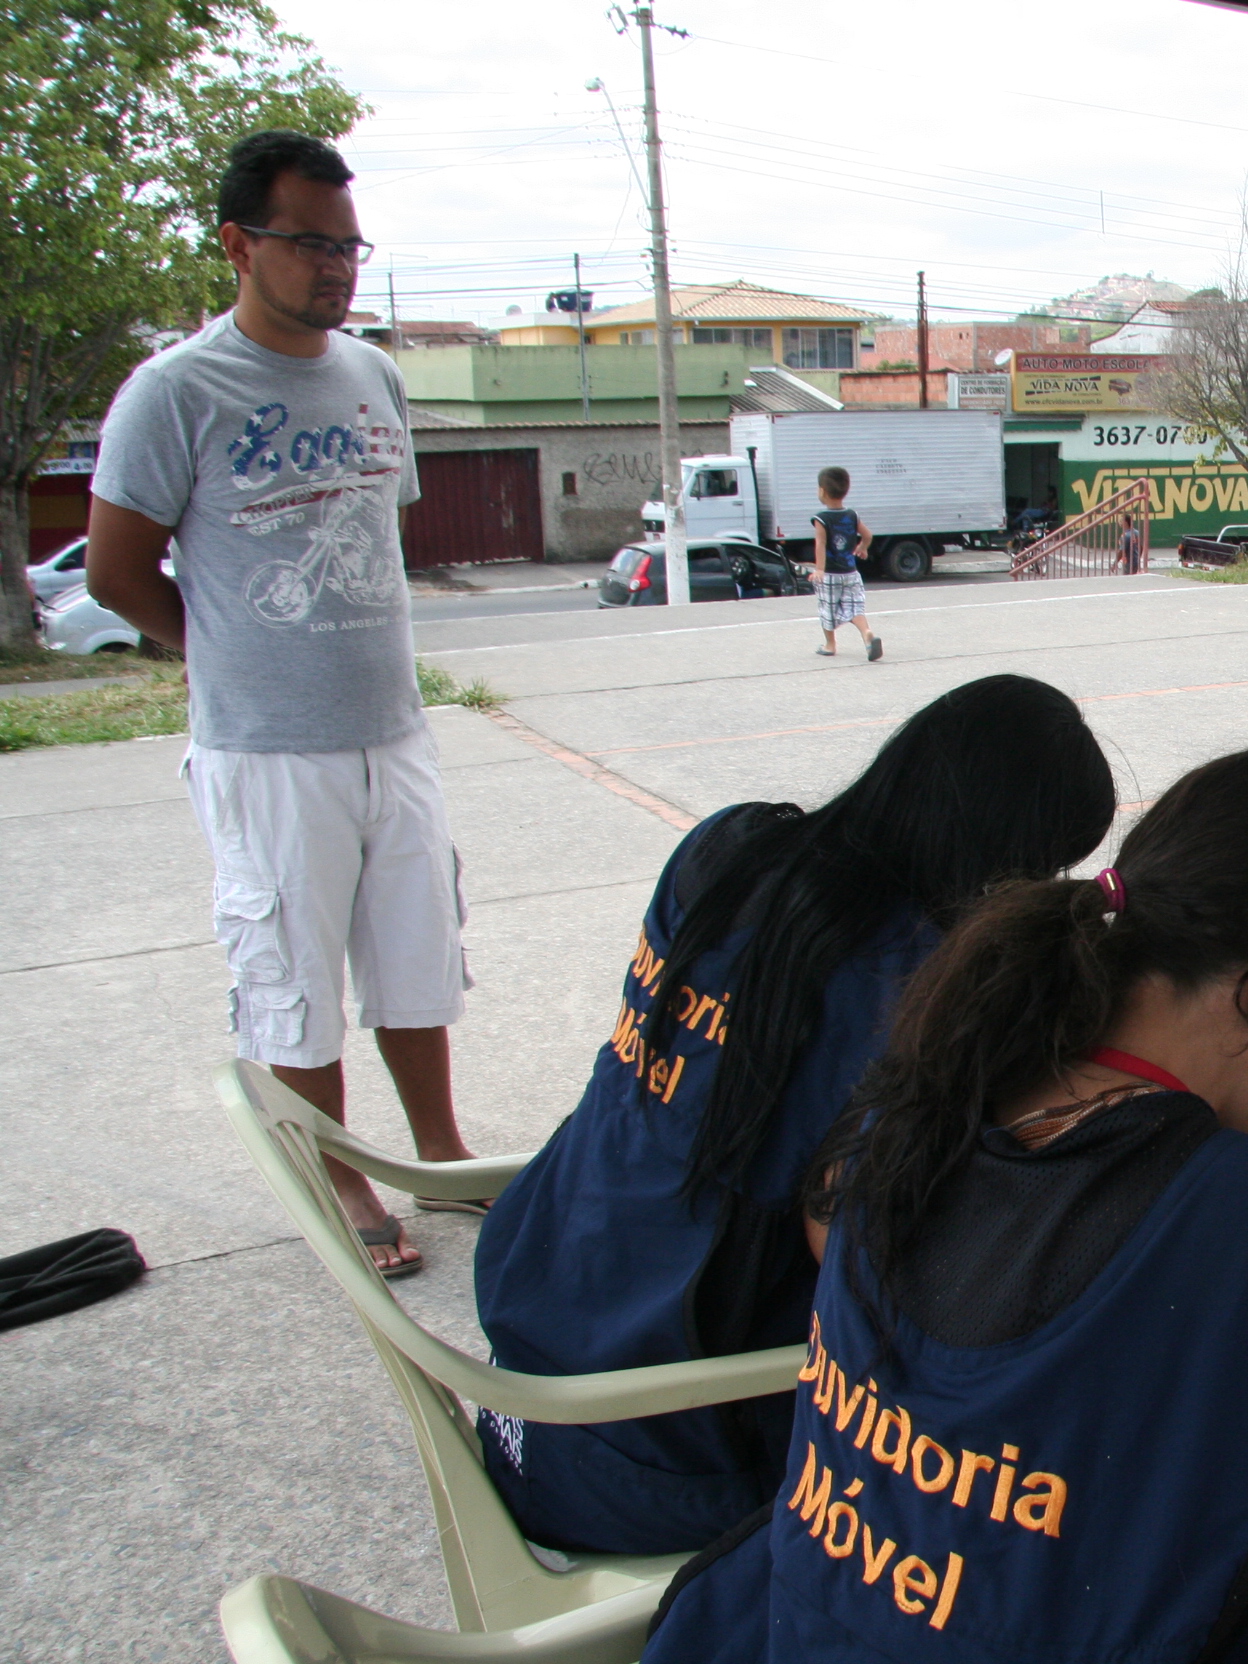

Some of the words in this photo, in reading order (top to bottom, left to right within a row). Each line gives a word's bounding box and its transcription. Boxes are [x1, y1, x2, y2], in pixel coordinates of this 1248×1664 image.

[1022, 358, 1058, 370] AUTO
[1062, 358, 1099, 370] MOTO
[1102, 358, 1150, 370] ESCOLA
[960, 386, 968, 395] DE
[969, 386, 1006, 395] CONDUTORES
[1030, 379, 1061, 390] VIDA
[1064, 380, 1099, 392] NOVA
[248, 519, 282, 537] EST
[287, 512, 306, 528] 70
[309, 622, 336, 633] LOS
[340, 616, 389, 630] ANGELES
[798, 1310, 1068, 1538] Ouvidoria
[787, 1440, 964, 1632] Móvel
